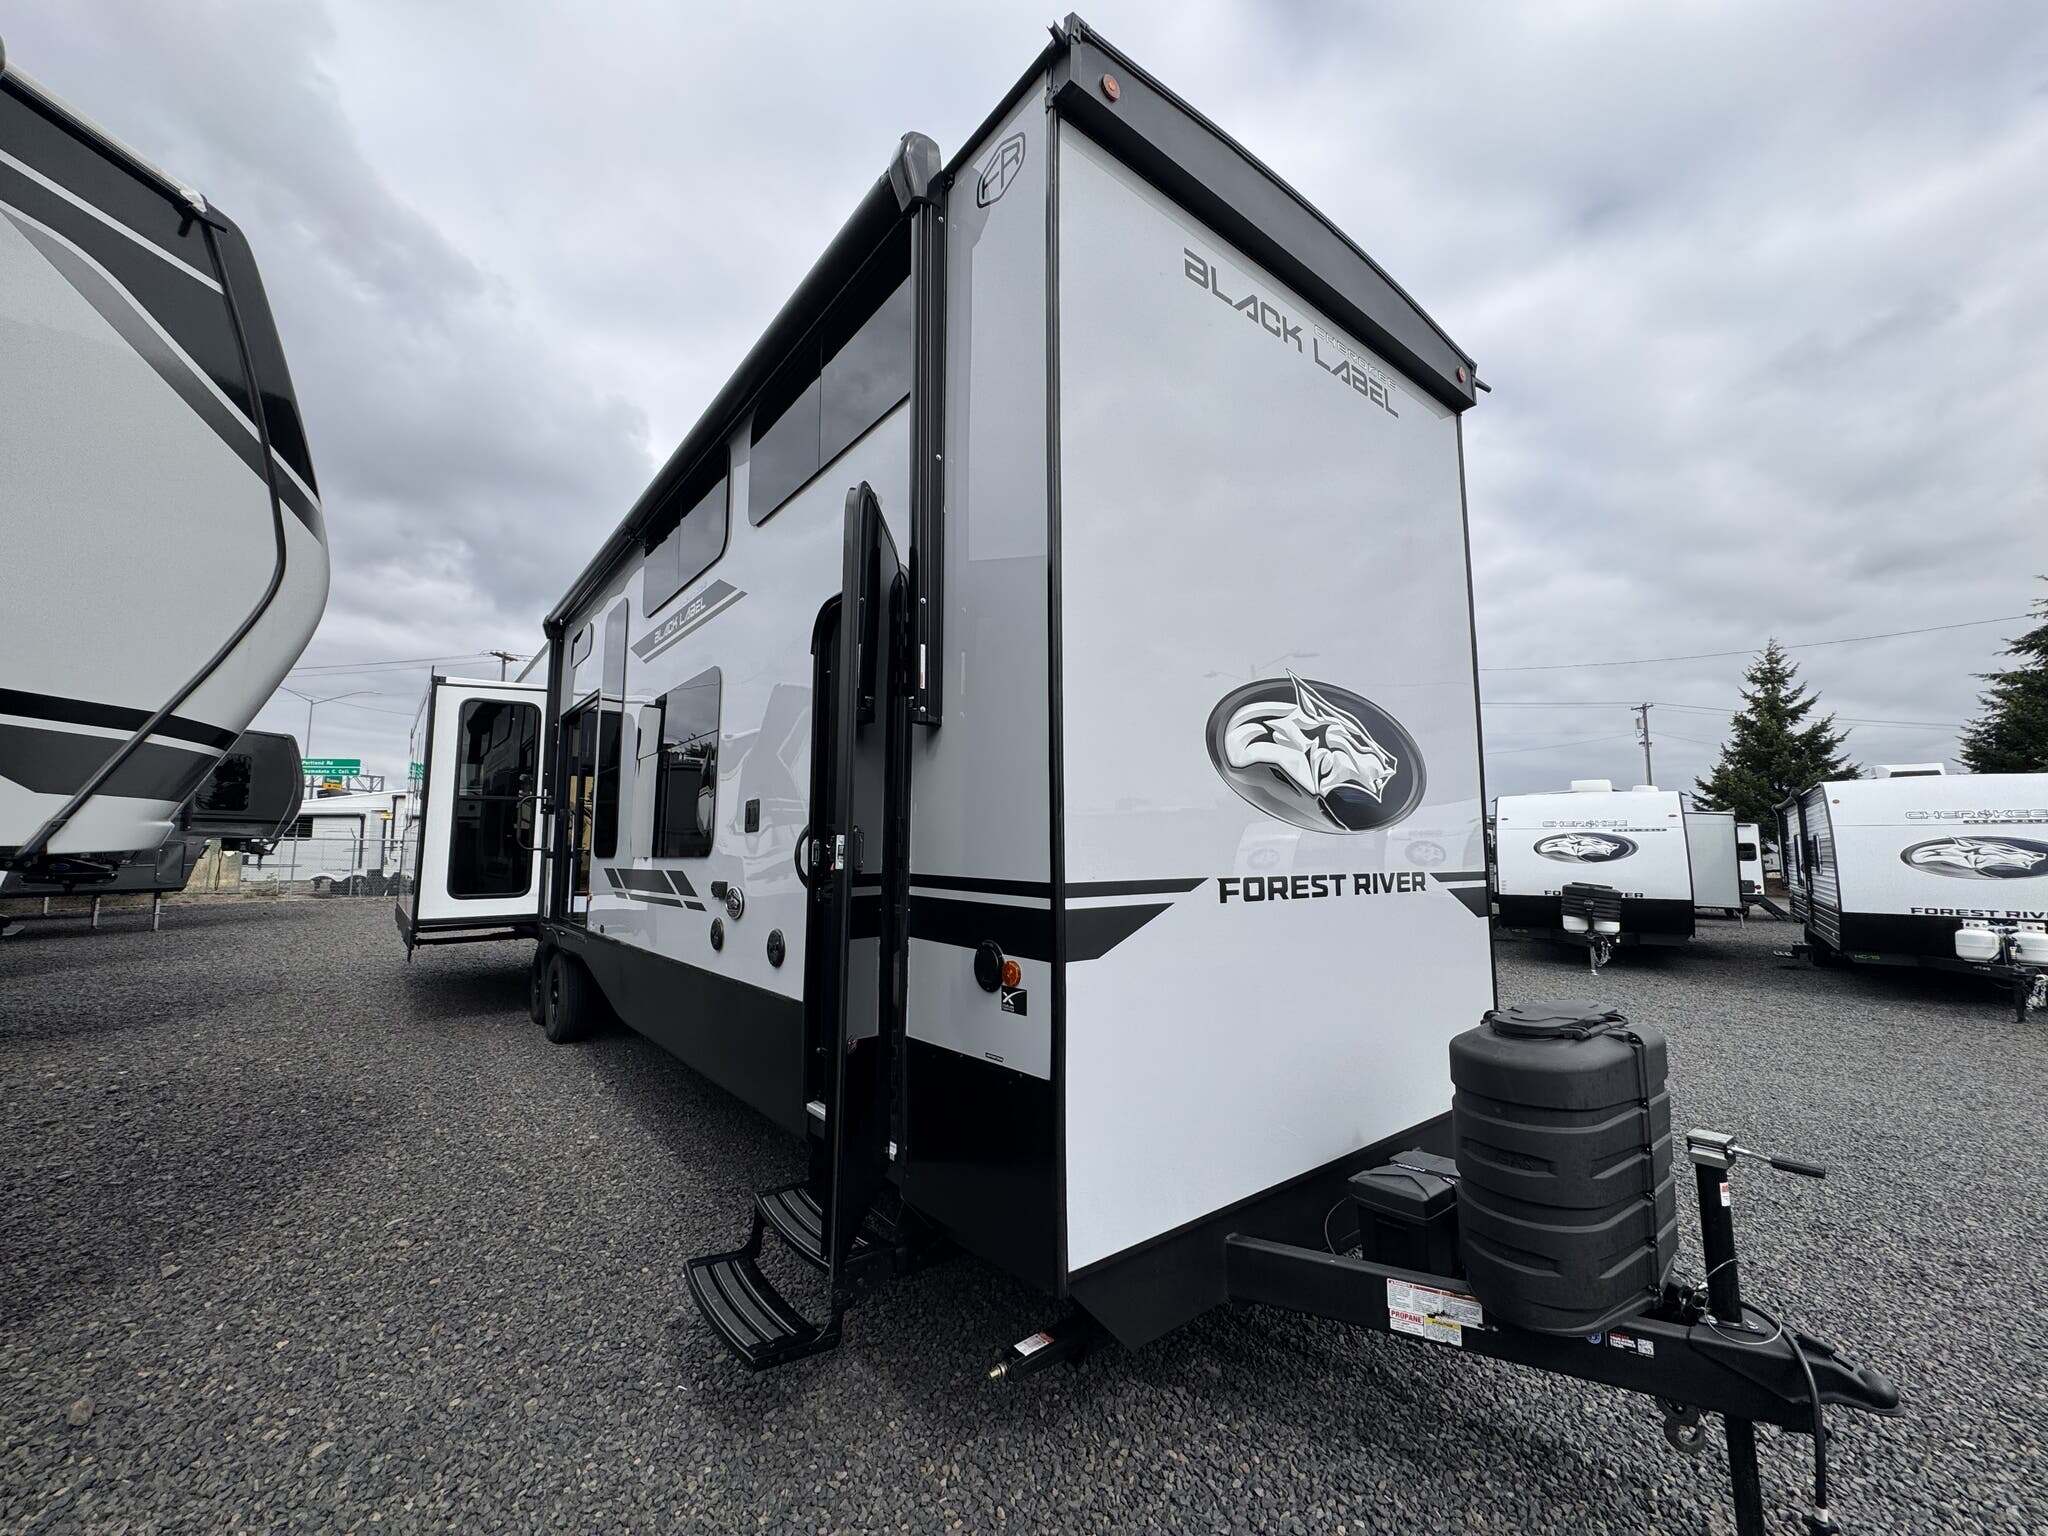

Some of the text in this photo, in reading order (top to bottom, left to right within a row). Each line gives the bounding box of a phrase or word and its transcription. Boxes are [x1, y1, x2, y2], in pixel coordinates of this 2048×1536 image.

[1184, 247, 1399, 419] BLACK LABEL
[1313, 324, 1399, 392] CHEROKEE
[654, 597, 706, 644] BLACK LABEL
[1905, 809, 2048, 819] CHEROKEE
[1217, 871, 1427, 904] FOREST RIVER
[1910, 907, 1999, 917] FOREST
[1391, 1310, 1422, 1324] PROPANE
